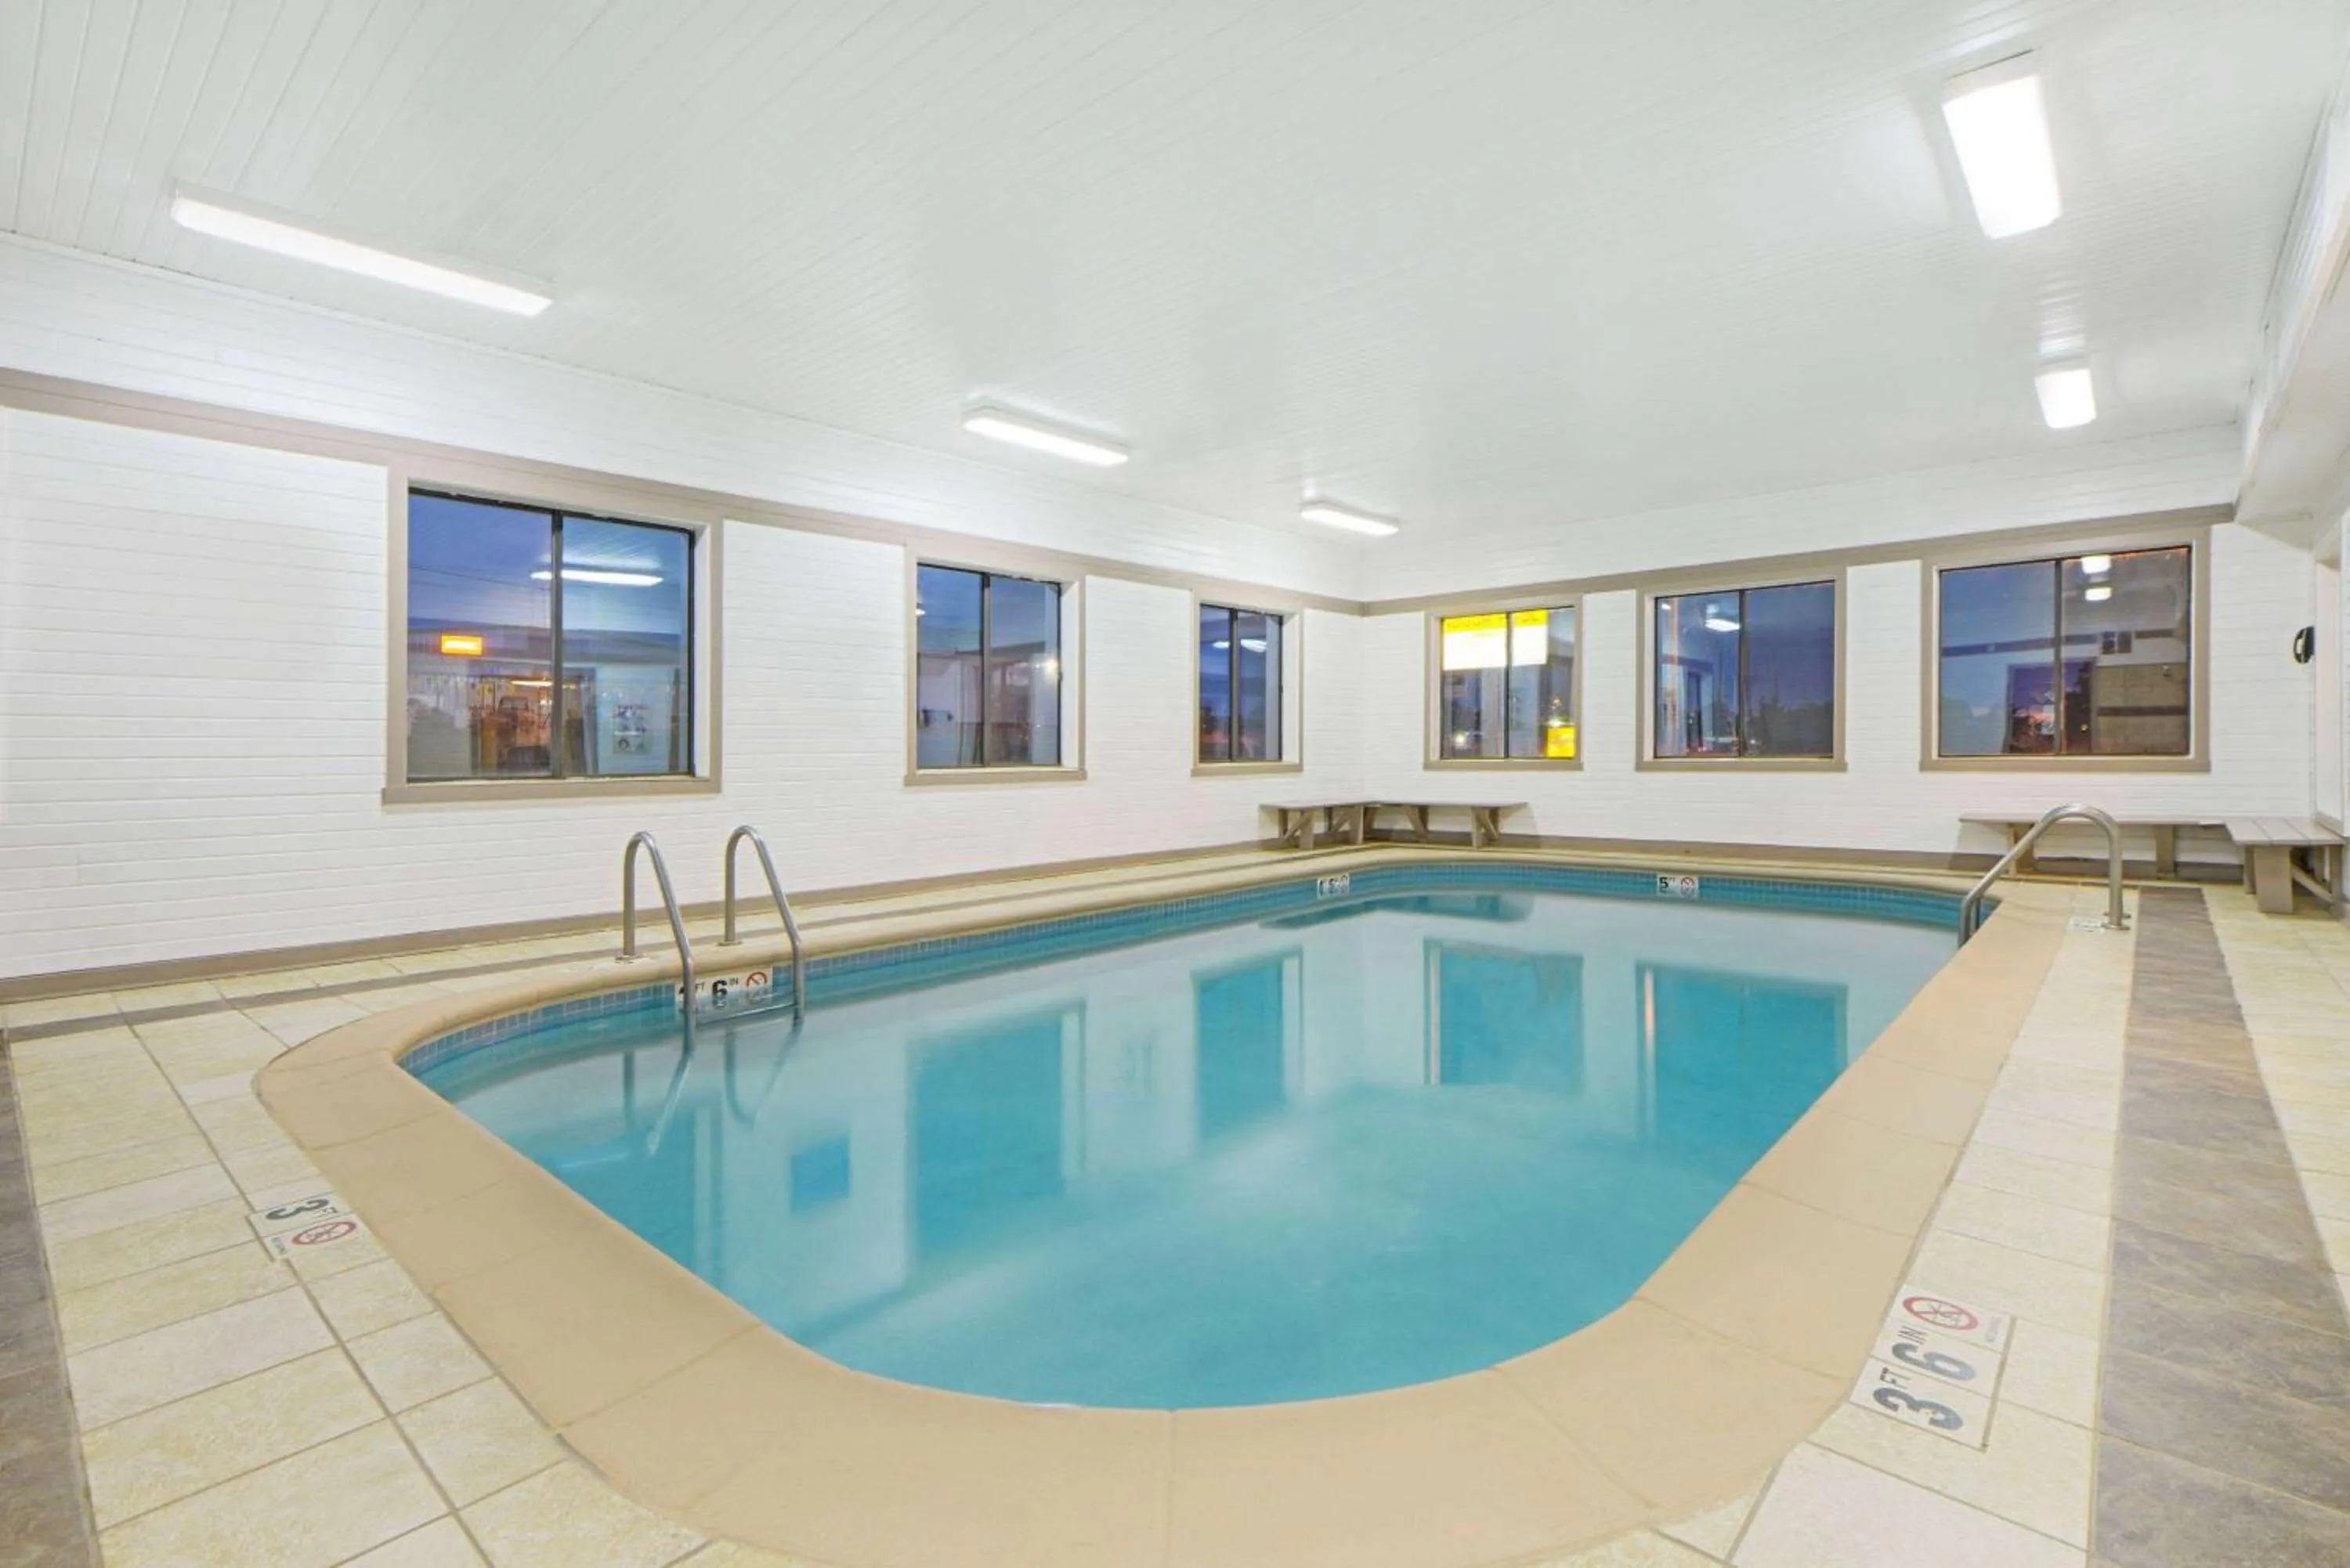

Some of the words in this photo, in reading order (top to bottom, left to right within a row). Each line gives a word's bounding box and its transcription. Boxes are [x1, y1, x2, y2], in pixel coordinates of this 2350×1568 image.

[712, 979, 728, 997] 6
[266, 1198, 330, 1220] 3
[1897, 1324, 1929, 1345] IN
[1892, 1342, 1977, 1382] 6
[1880, 1367, 1912, 1390] FT
[1872, 1387, 1964, 1431] 3
